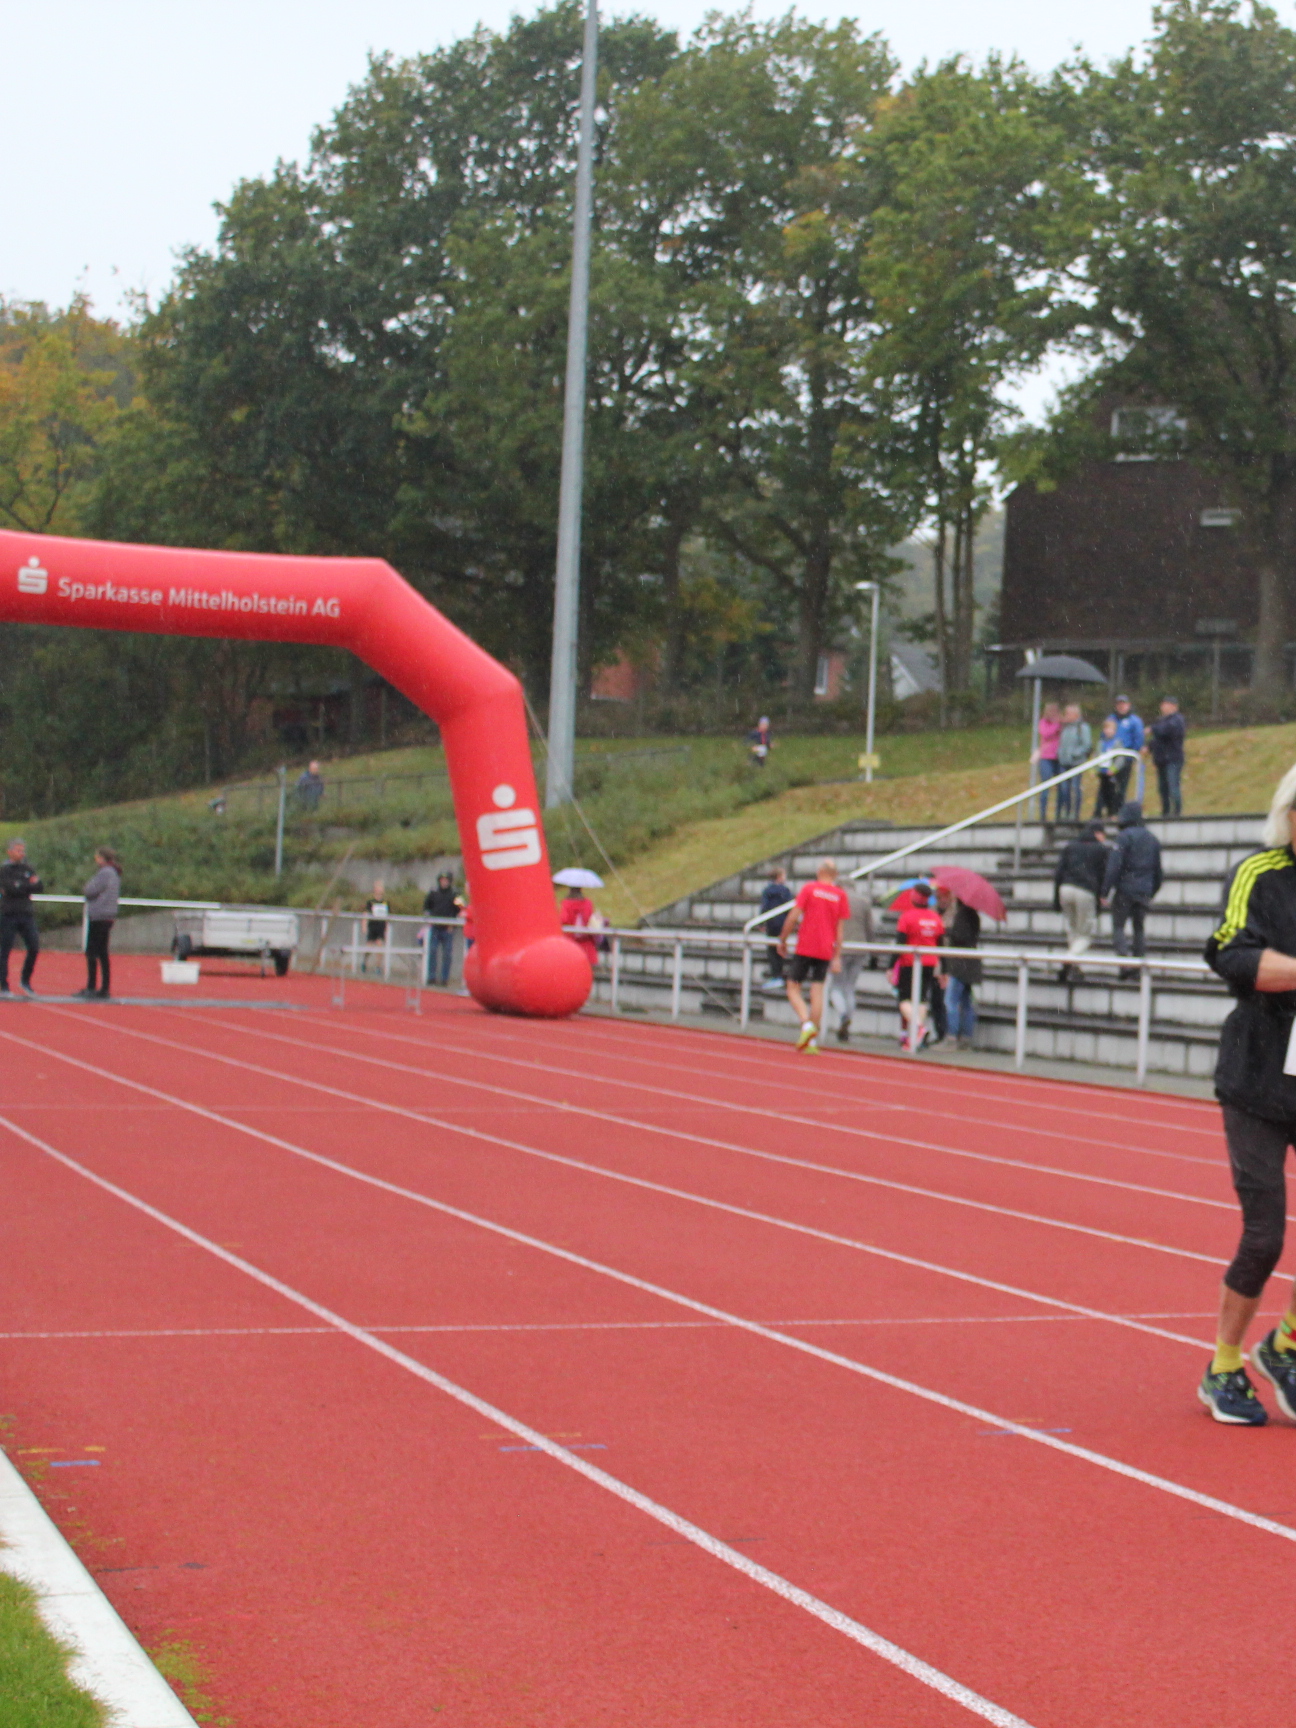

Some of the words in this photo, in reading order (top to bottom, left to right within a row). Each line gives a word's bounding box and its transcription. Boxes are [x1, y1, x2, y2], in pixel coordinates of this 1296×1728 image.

[57, 576, 163, 605] Sparkasse
[168, 587, 308, 616] Mittelholstein
[311, 597, 341, 618] AG
